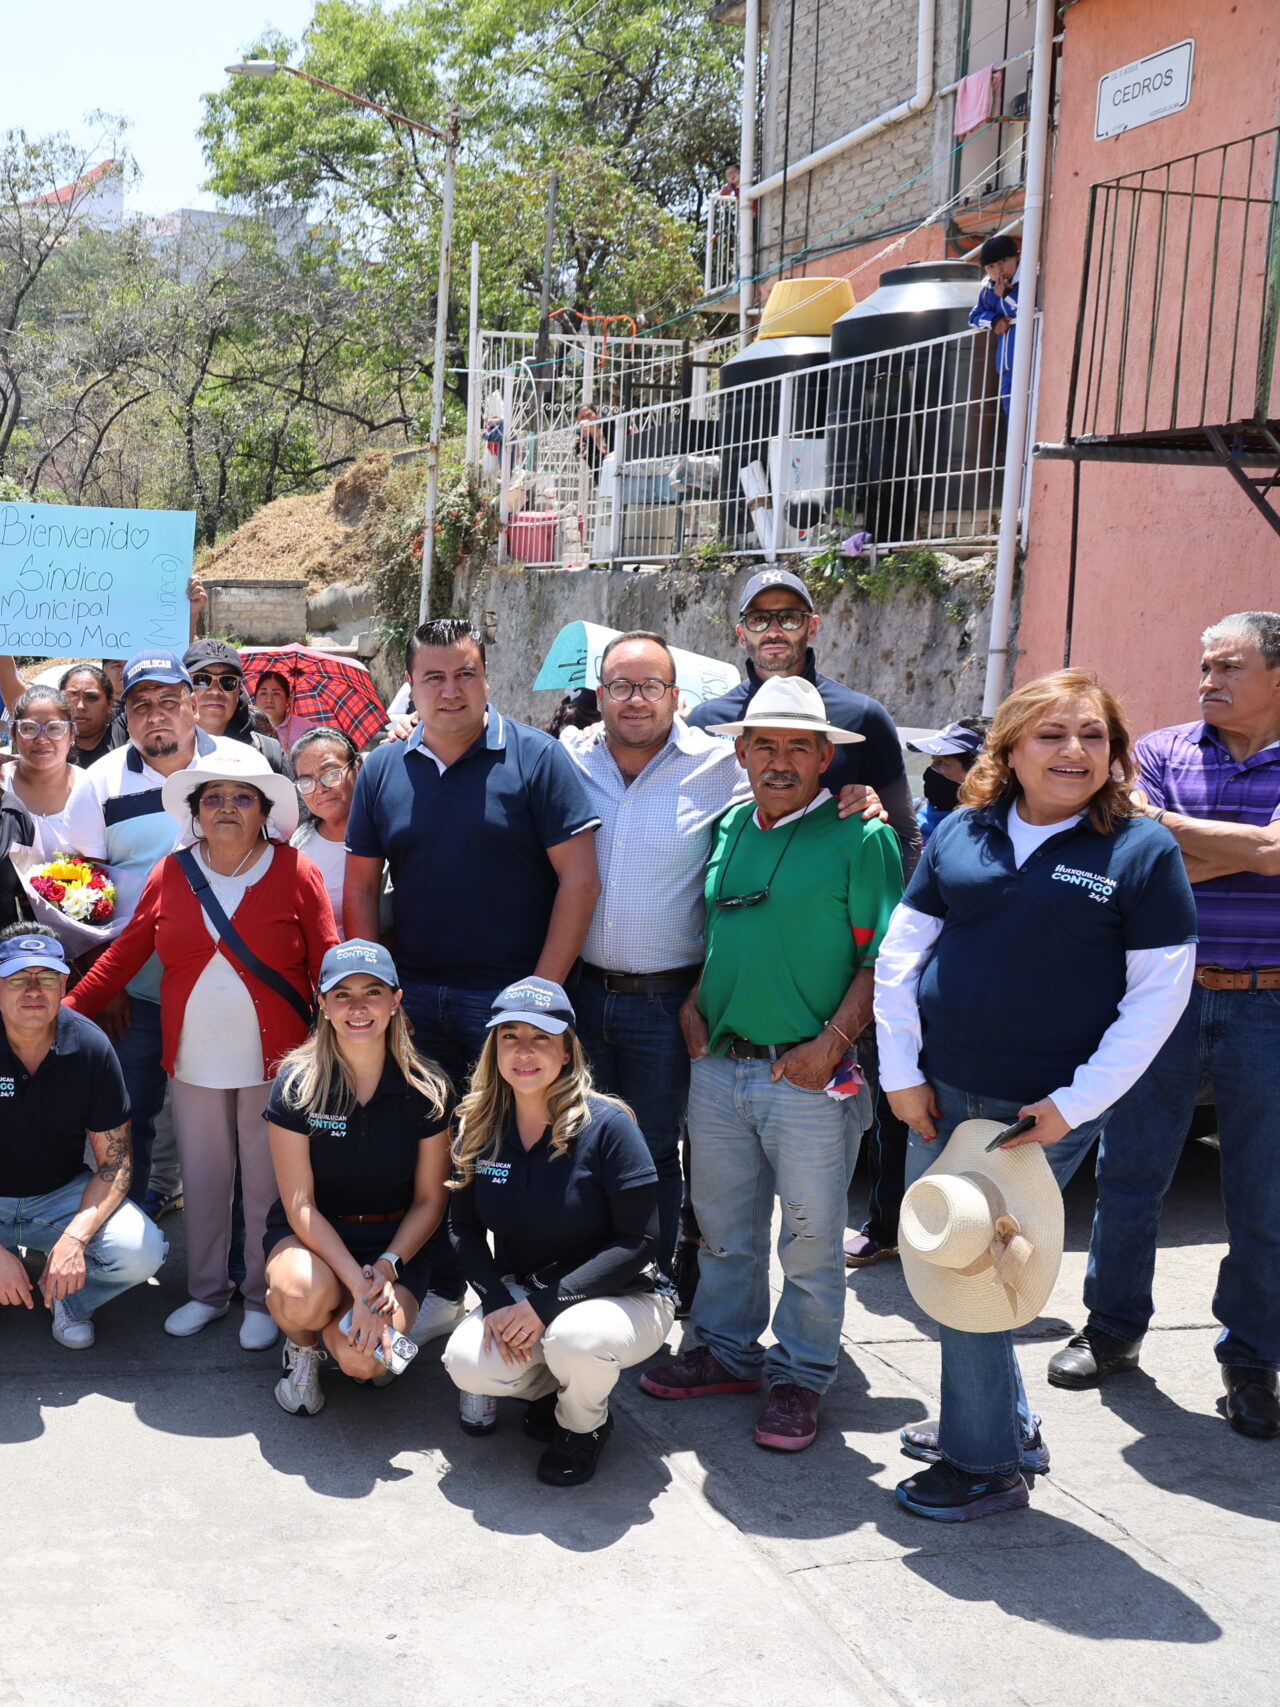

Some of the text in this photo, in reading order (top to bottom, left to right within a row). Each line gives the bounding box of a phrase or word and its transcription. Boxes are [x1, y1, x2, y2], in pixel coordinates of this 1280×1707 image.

[1112, 68, 1174, 107] CEDROS
[0, 589, 110, 624] Municipal
[80, 624, 132, 648] Mac
[1051, 872, 1113, 896] CONTIGO
[1055, 864, 1117, 888] HUIXQUILUCAN
[1088, 892, 1109, 904] 24/7
[336, 950, 376, 960] CONTIGO
[504, 990, 551, 1003] CONTIGO
